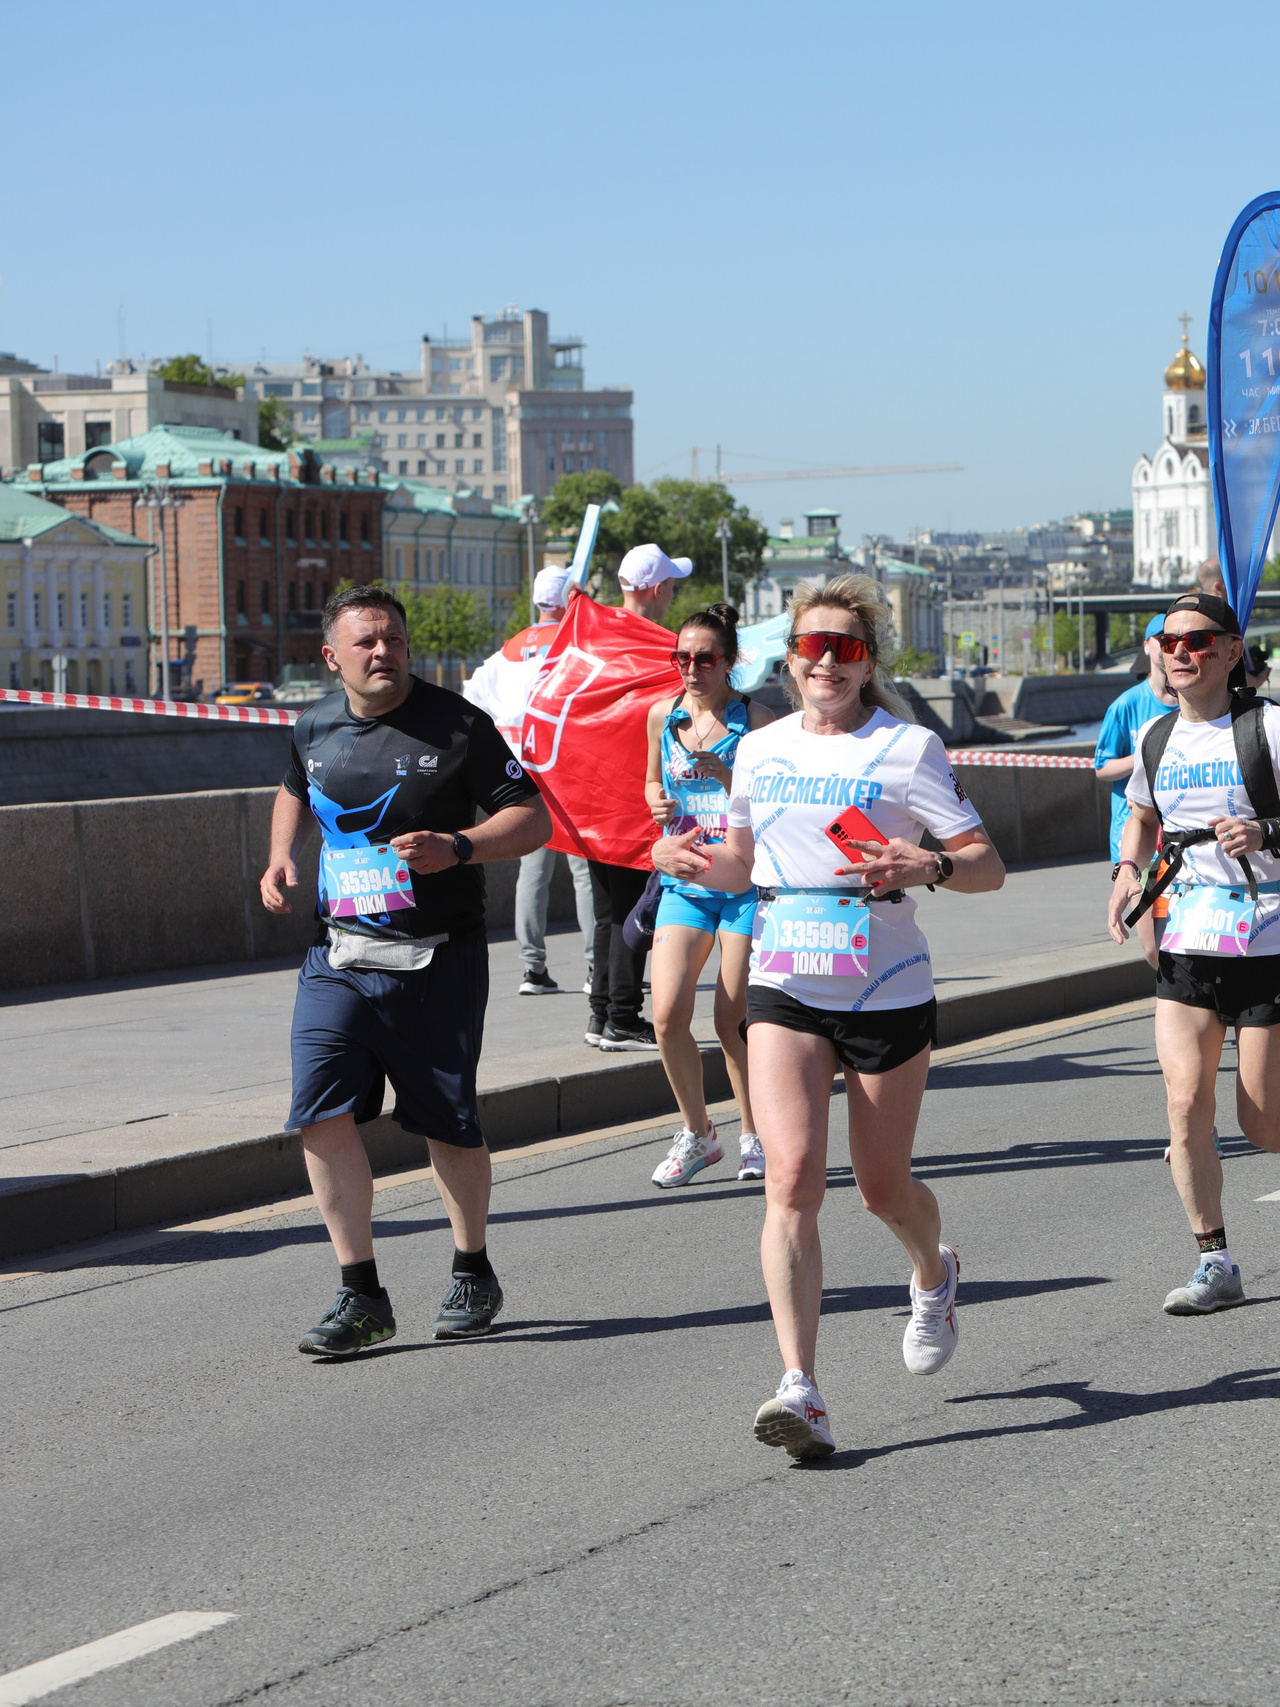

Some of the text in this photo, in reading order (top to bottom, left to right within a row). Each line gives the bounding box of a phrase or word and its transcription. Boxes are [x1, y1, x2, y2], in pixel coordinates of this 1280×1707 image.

[1243, 269, 1268, 295] 10
[1239, 348, 1252, 378] 1
[1241, 387, 1261, 398] ЧАС
[750, 772, 883, 810] ПЕЙСМЕЙКЕР
[686, 794, 726, 812] 31456
[339, 866, 395, 895] 35394
[398, 871, 406, 881] E
[352, 894, 388, 915] 10КМ
[779, 919, 849, 950] 33596
[1239, 922, 1246, 932] E
[855, 936, 863, 947] E
[791, 951, 834, 976] 10КМ
[877, 961, 906, 984] #ВОЛНЕНИЕ
[860, 979, 881, 1001] #ТРЕПЕТ
